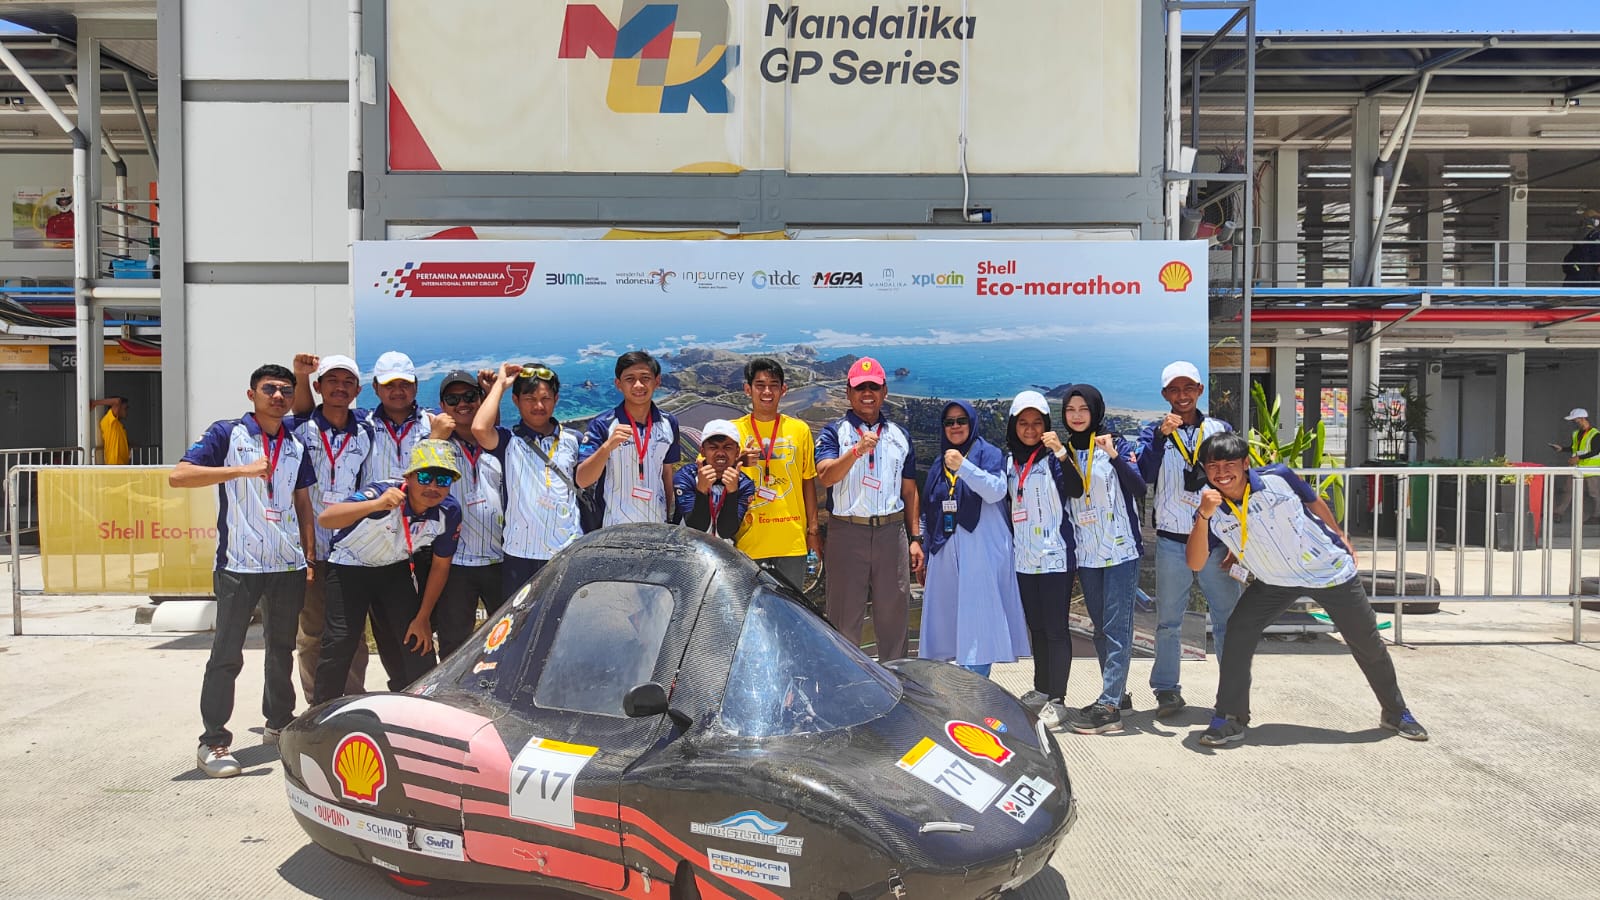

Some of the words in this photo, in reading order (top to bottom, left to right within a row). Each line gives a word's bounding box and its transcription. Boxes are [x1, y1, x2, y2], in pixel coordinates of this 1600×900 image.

[764, 3, 977, 40] Mandalika
[760, 47, 823, 84] GP
[828, 49, 961, 86] Series
[977, 260, 1016, 275] Shell
[545, 273, 584, 285] BUMN
[615, 276, 654, 285] indonesia
[682, 271, 745, 284] injourney
[767, 270, 801, 286] itdc
[911, 271, 964, 287] xplorin
[976, 275, 1141, 296] Eco-marathon
[98, 520, 145, 540] Shell
[516, 765, 572, 802] 717
[933, 759, 977, 796] 717
[1010, 782, 1042, 807] UPI
[318, 804, 346, 827] DUPONT
[366, 822, 402, 839] SCHMID
[425, 835, 454, 849] SwRI
[711, 853, 787, 873] PENDIDIKAN
[712, 863, 780, 881] OTOMOTIF
[713, 859, 756, 872] TEKNIK
